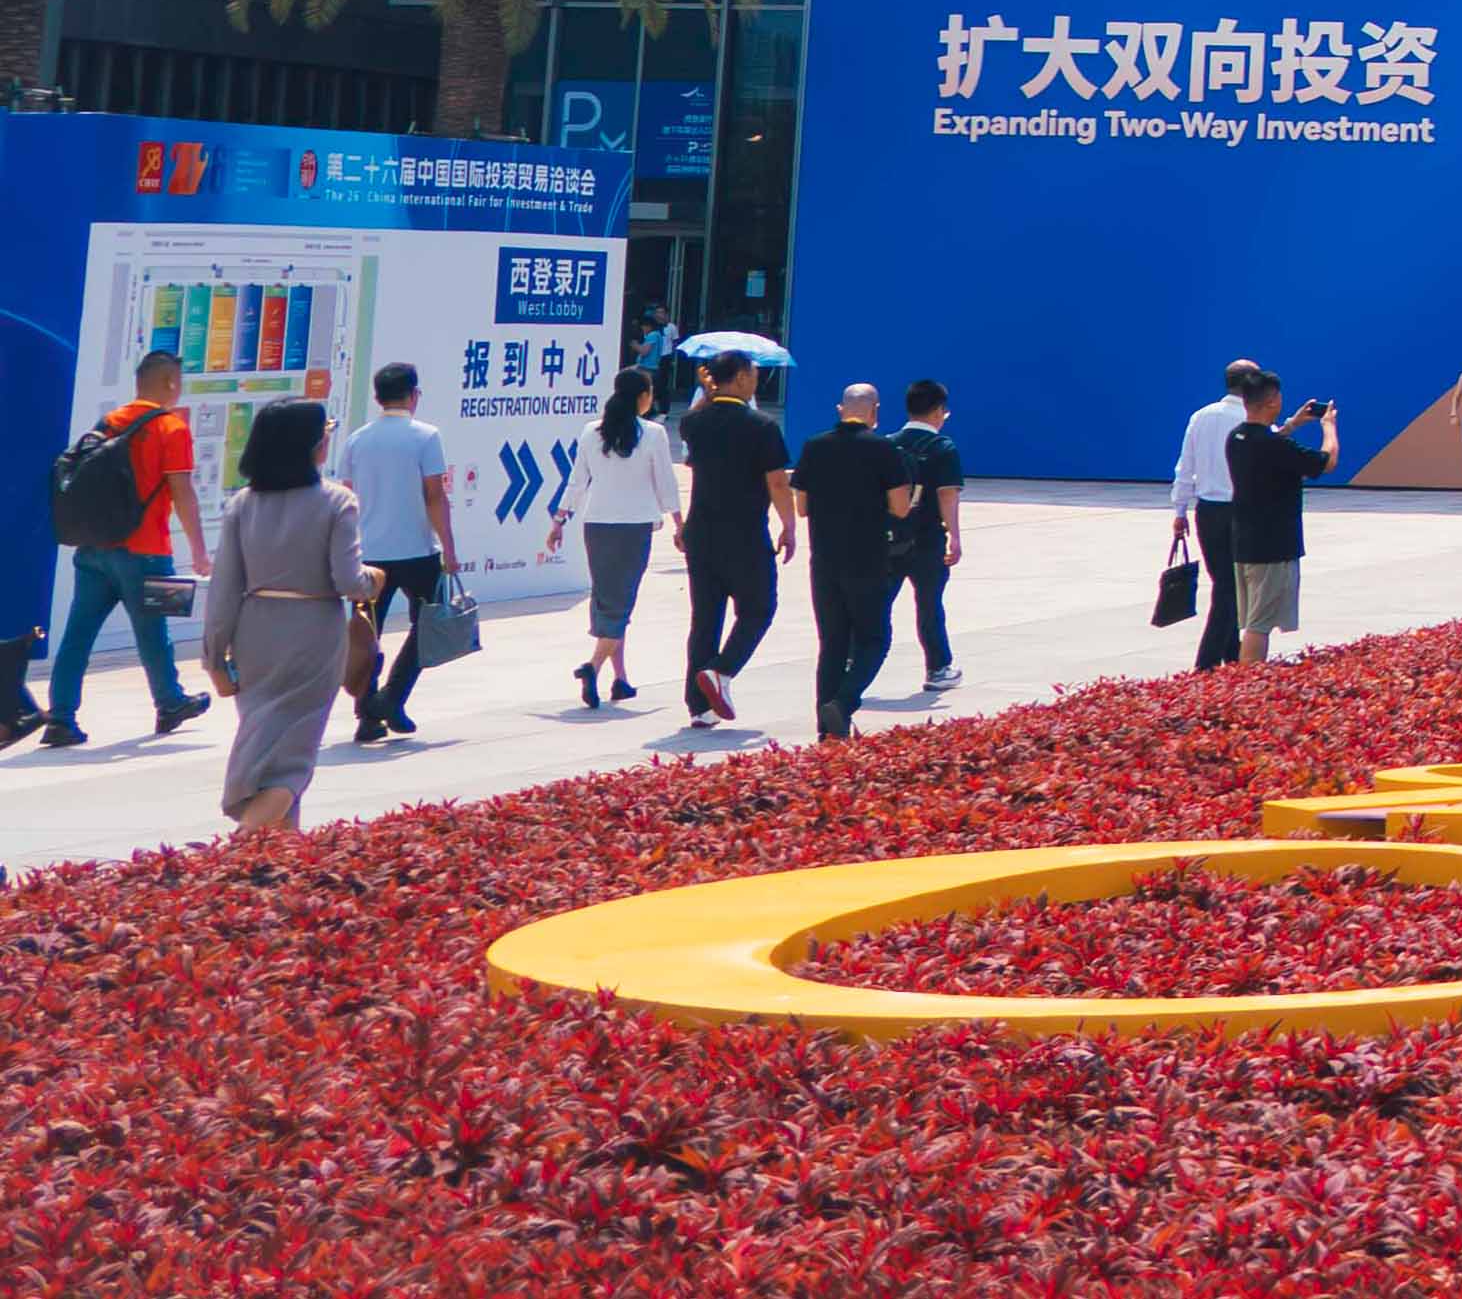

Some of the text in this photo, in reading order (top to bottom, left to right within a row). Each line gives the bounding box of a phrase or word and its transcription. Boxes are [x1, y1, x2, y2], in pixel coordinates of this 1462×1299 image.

[937, 13, 1438, 106] 扩大双向投资
[933, 108, 1435, 147] Expanding Two-Way Investment
[326, 152, 596, 196] 第二十六届中国国际投资贸易洽谈会
[400, 192, 465, 207] International
[510, 257, 597, 297] 西登录厅
[518, 300, 584, 320] West Lobby
[462, 339, 600, 390] 报到中心
[461, 395, 598, 418] REGISTRATION CENTER
